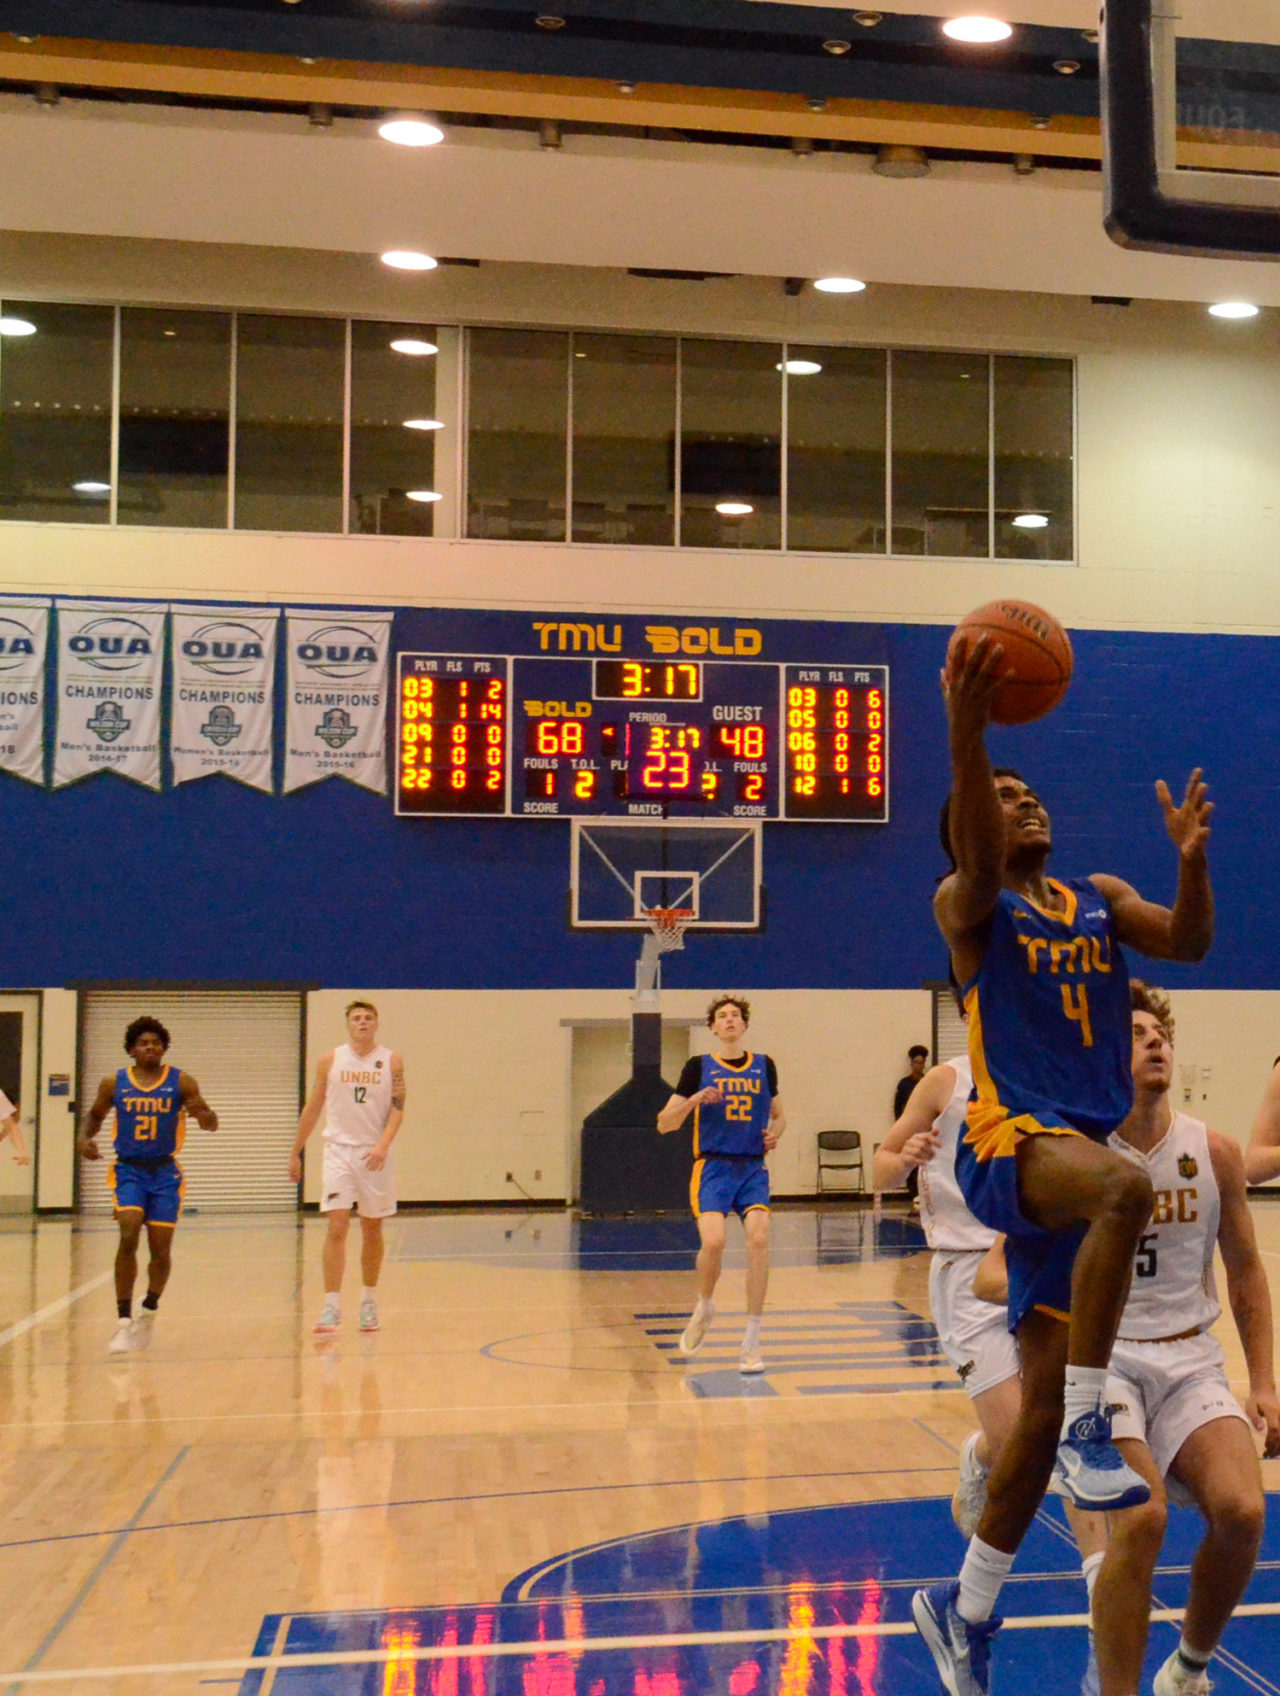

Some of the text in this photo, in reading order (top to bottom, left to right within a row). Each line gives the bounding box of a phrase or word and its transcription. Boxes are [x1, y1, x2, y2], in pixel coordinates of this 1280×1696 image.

[68, 636, 151, 654] OUA
[532, 622, 762, 655] TMU BOLD
[182, 640, 264, 659] OUA
[297, 643, 378, 662] OUA
[415, 661, 491, 672] PLYR FLS PTS
[799, 671, 870, 682] PLYR FLS PTS
[403, 677, 433, 697] 03
[460, 681, 467, 697] 1
[488, 680, 502, 699] 2
[623, 663, 697, 696] 3:17
[66, 685, 153, 699] CHAMPIONS
[179, 689, 265, 704] CHAMPIONS
[294, 692, 380, 706] CHAMPIONS
[788, 687, 881, 708] 03 0 6
[403, 700, 502, 719] 04 1 14
[523, 700, 592, 718] BOLD
[629, 712, 667, 722] PERIOD
[712, 705, 763, 721] GUEST
[788, 709, 881, 730] 05 0 0
[403, 722, 502, 743] 09 0 0
[537, 721, 583, 754] 68
[651, 727, 700, 749] 3:17
[720, 726, 764, 758] 48
[788, 732, 881, 752] 06 0 2
[402, 745, 502, 766] 21 0 0
[523, 758, 559, 769] FOULS
[795, 753, 881, 774] 10 0 0
[643, 751, 690, 787] 23
[734, 761, 767, 773] FOULS
[401, 768, 501, 789] 22 0 2
[545, 770, 594, 799] 1 2
[745, 775, 762, 799] 2
[795, 776, 881, 796] 12 1 6
[523, 802, 559, 814] SCORE
[733, 805, 767, 816] SCORE
[1017, 934, 1112, 974] TMU
[1060, 983, 1094, 1047] 4
[340, 1070, 381, 1085] UNBC
[714, 1077, 761, 1094] TMU
[122, 1097, 171, 1113] TMU
[354, 1087, 366, 1103] 12
[725, 1095, 752, 1121] 22
[134, 1116, 158, 1140] 21
[1136, 1232, 1158, 1277] 5
